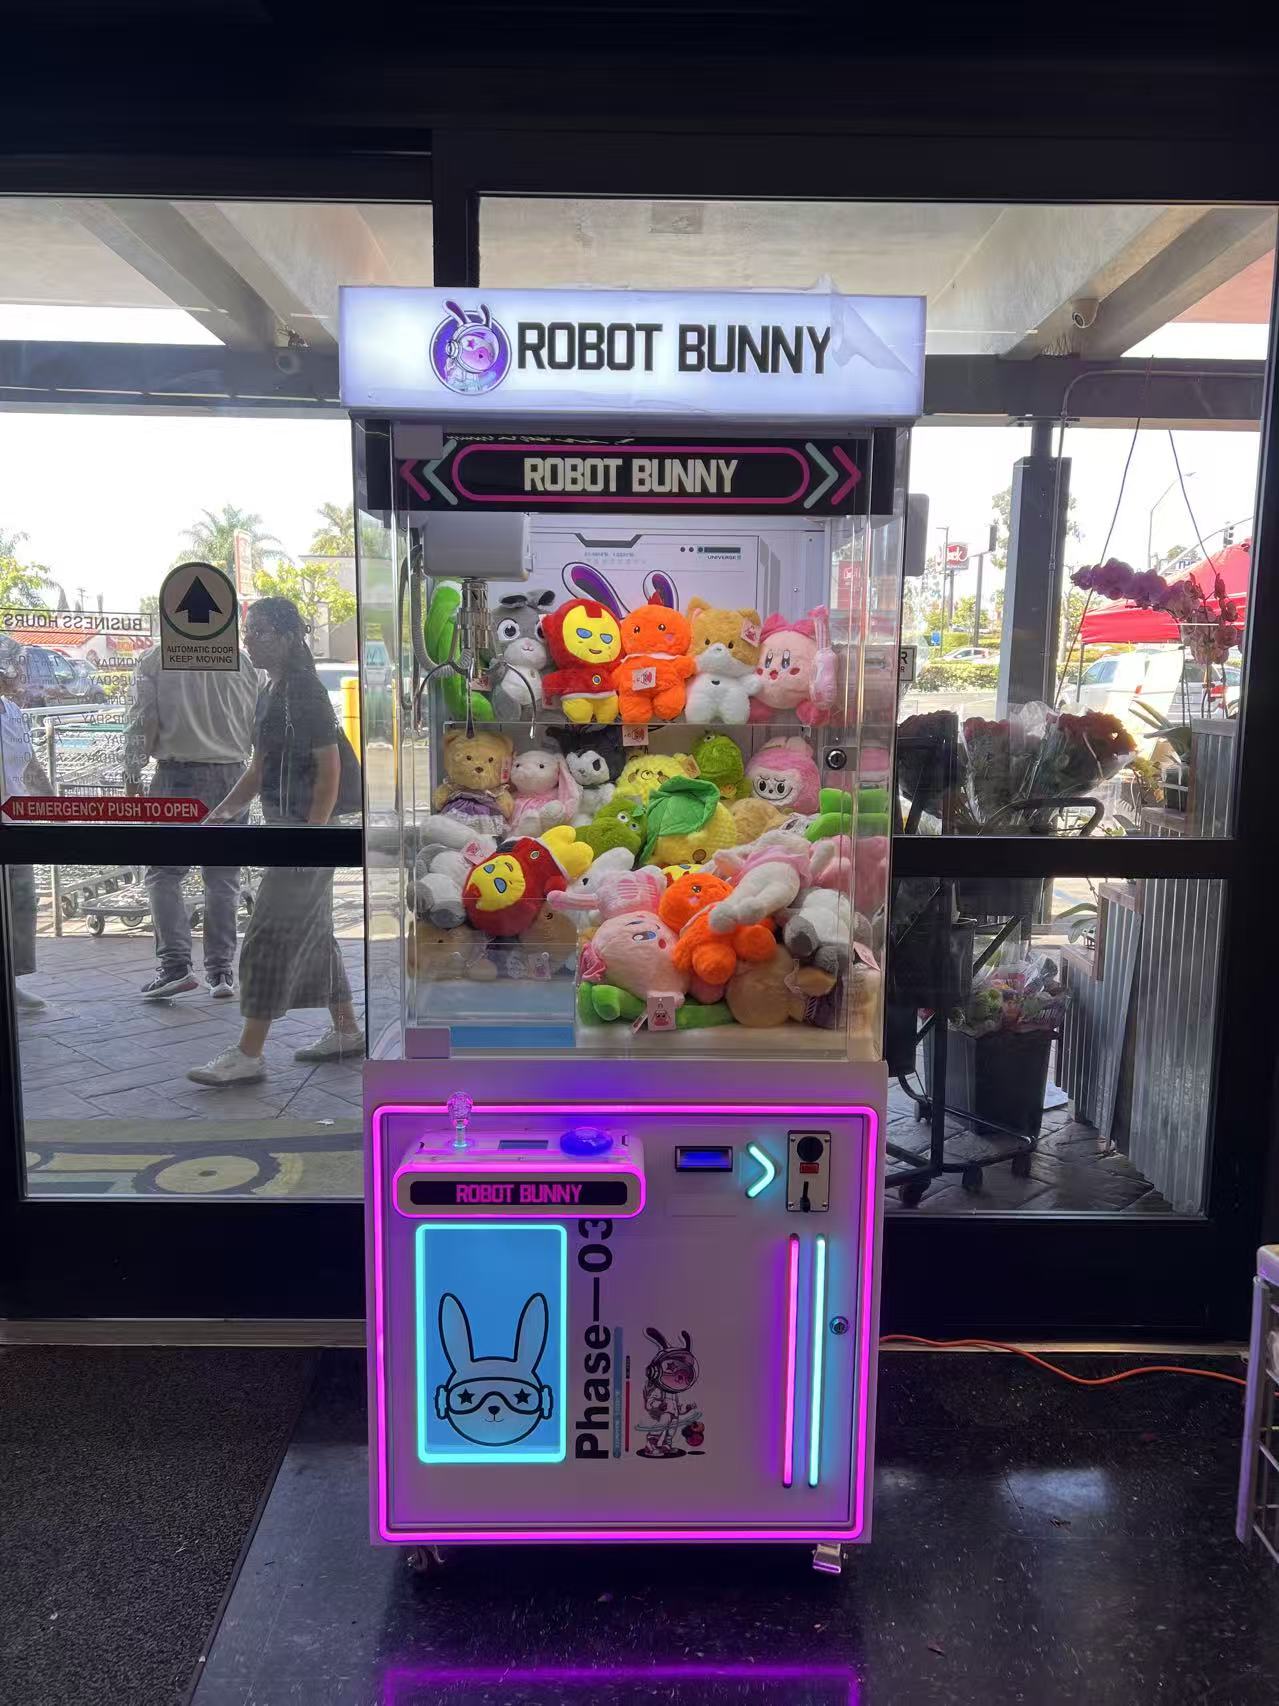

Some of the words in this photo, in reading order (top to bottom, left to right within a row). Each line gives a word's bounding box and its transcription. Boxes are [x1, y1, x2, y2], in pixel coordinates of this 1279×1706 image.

[517, 321, 663, 371] ROBOT
[677, 324, 832, 375] BUNNY
[523, 457, 624, 493] ROBOT
[631, 457, 739, 493] BUNNY
[167, 645, 210, 654] AUTOMATIC
[211, 646, 234, 654] DOOR
[169, 655, 193, 663] KEEP
[196, 655, 233, 664] MOVING
[12, 801, 26, 817] IN
[26, 801, 105, 817] EMERGENCY
[108, 801, 142, 817] PUSH
[145, 801, 161, 817] TO
[163, 802, 199, 817] OPEN
[455, 1184, 513, 1204] ROBOT
[519, 1184, 583, 1204] BUNNY
